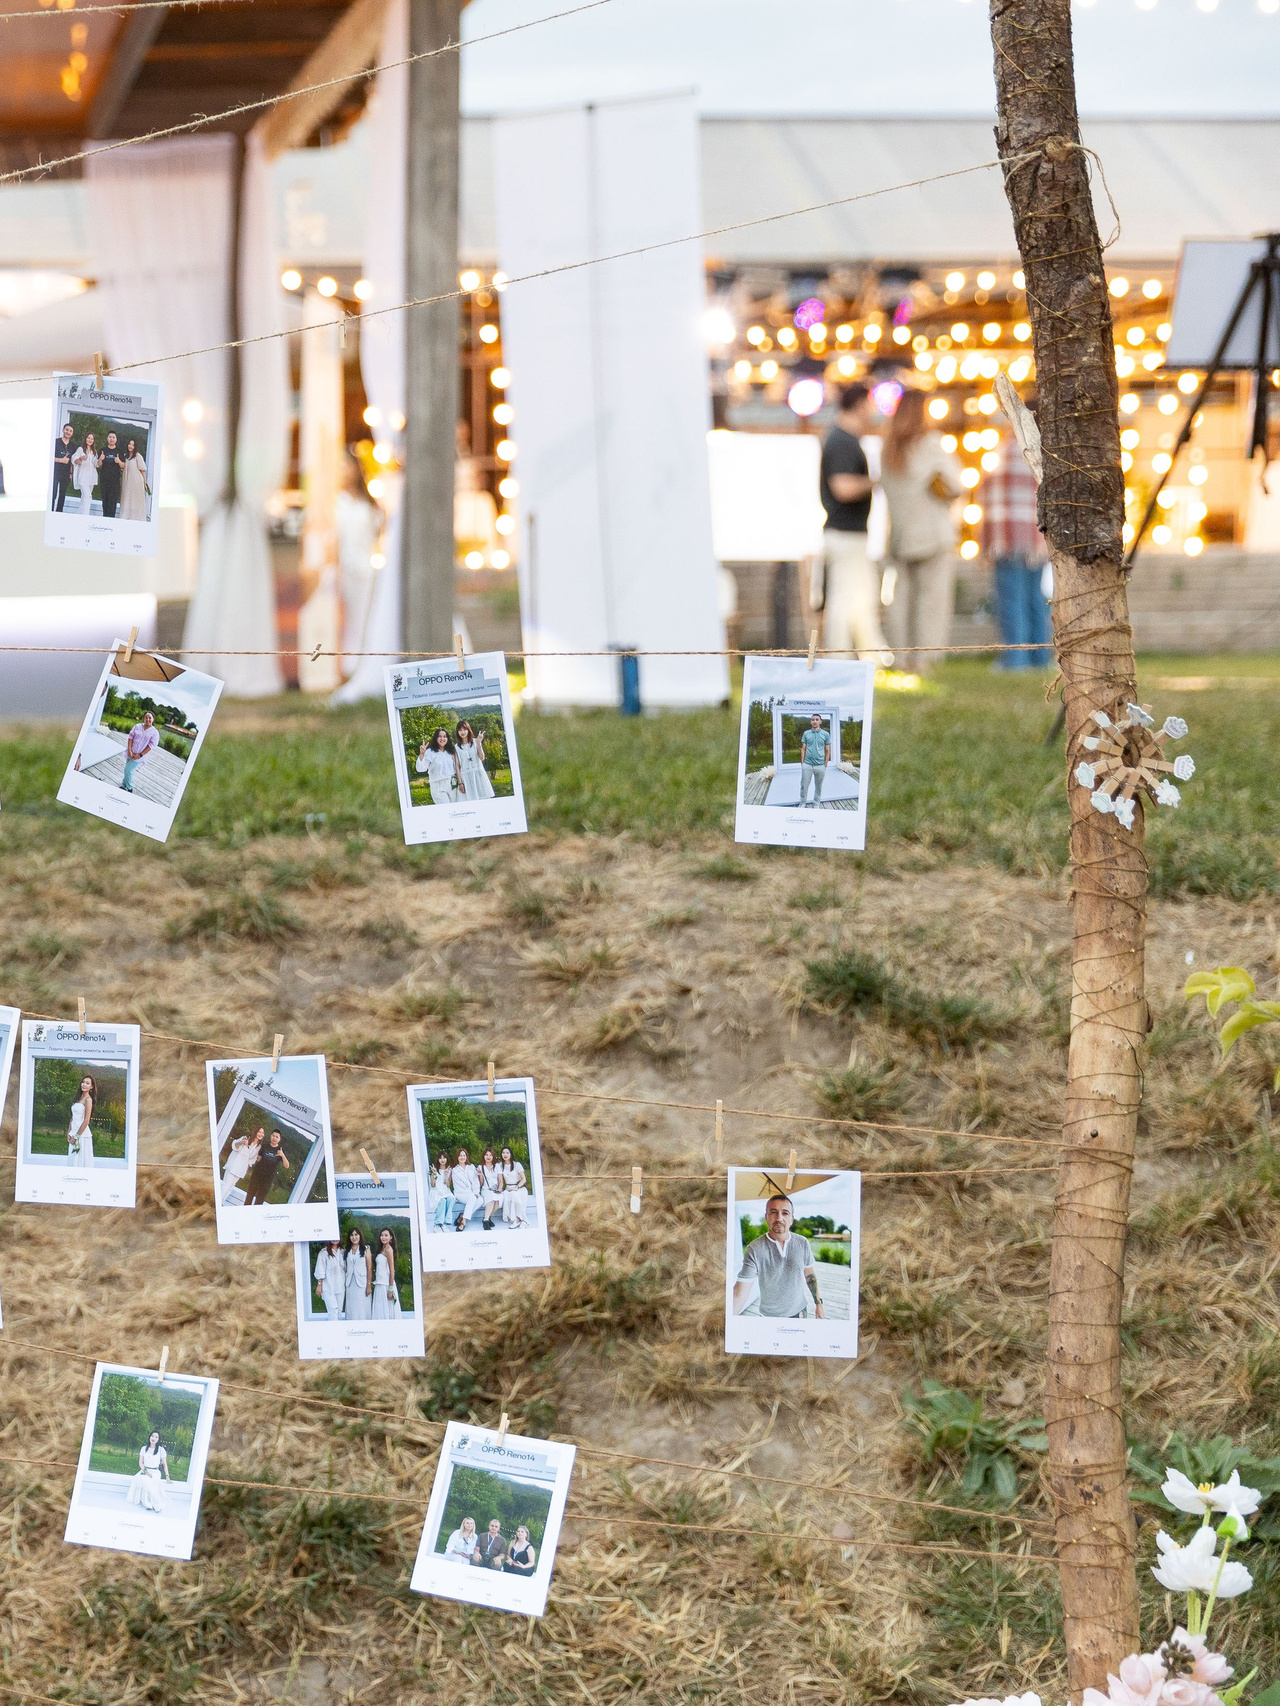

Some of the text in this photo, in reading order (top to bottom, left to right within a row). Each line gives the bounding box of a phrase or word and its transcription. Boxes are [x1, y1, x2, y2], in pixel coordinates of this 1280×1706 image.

[89, 393, 133, 404] OPPO Reno14
[418, 672, 473, 686] OPPO Reno14
[57, 1033, 106, 1042] OPPO Reno14
[269, 1090, 309, 1114] OPPO Reno14
[336, 1181, 385, 1189] PPO Reno14
[482, 1446, 536, 1461] OPPO Reno14
